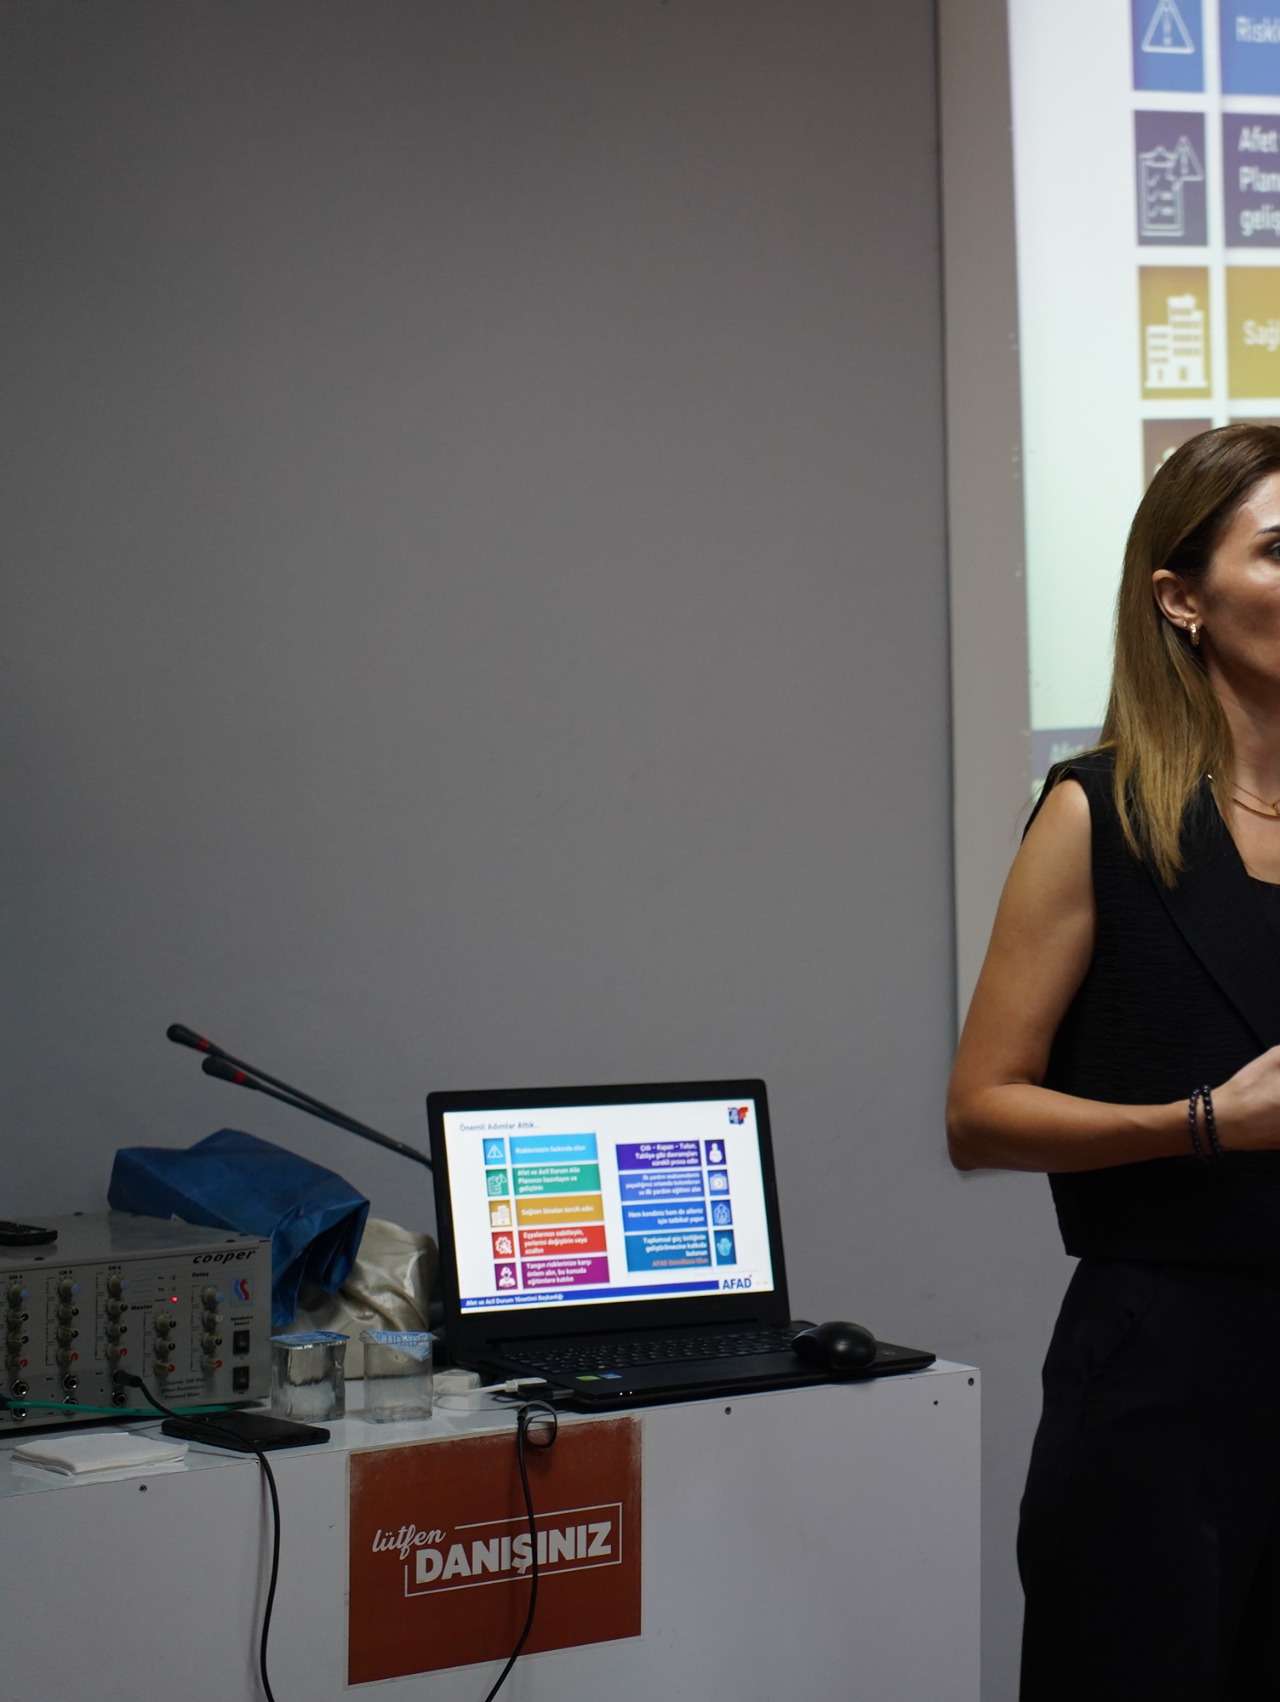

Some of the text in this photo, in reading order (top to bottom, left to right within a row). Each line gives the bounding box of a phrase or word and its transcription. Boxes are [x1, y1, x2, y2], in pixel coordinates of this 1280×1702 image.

[1238, 125, 1277, 153] Afet
[193, 1250, 256, 1264] cooper
[722, 1277, 752, 1290] AFAD
[372, 1524, 446, 1560] lütfen
[415, 1521, 612, 1585] DANIŞINIZ
